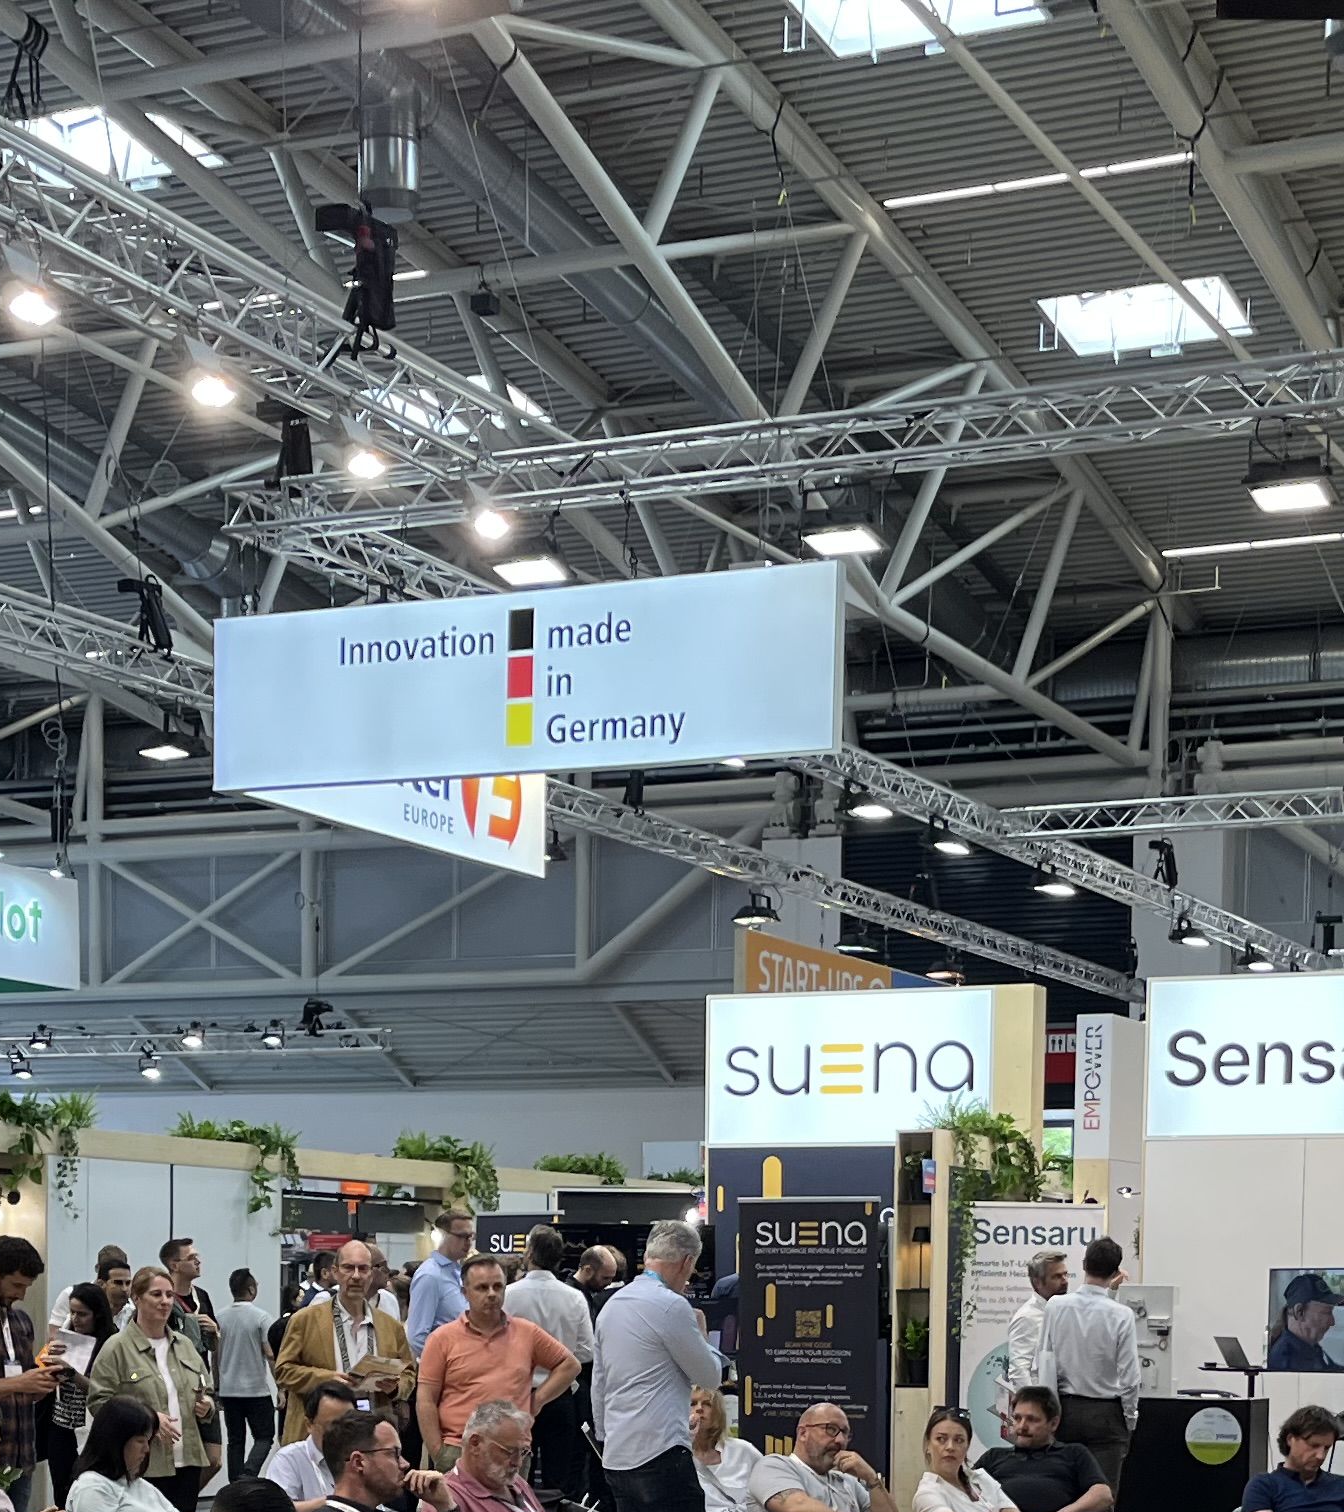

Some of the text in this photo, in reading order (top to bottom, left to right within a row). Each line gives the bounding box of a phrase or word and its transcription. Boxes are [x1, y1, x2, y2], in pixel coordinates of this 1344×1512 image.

[339, 612, 632, 666] Innovation made
[547, 666, 573, 697] in
[546, 711, 686, 745] Germany
[403, 803, 454, 835] EUROPE
[973, 1218, 1096, 1246] Sensaru
